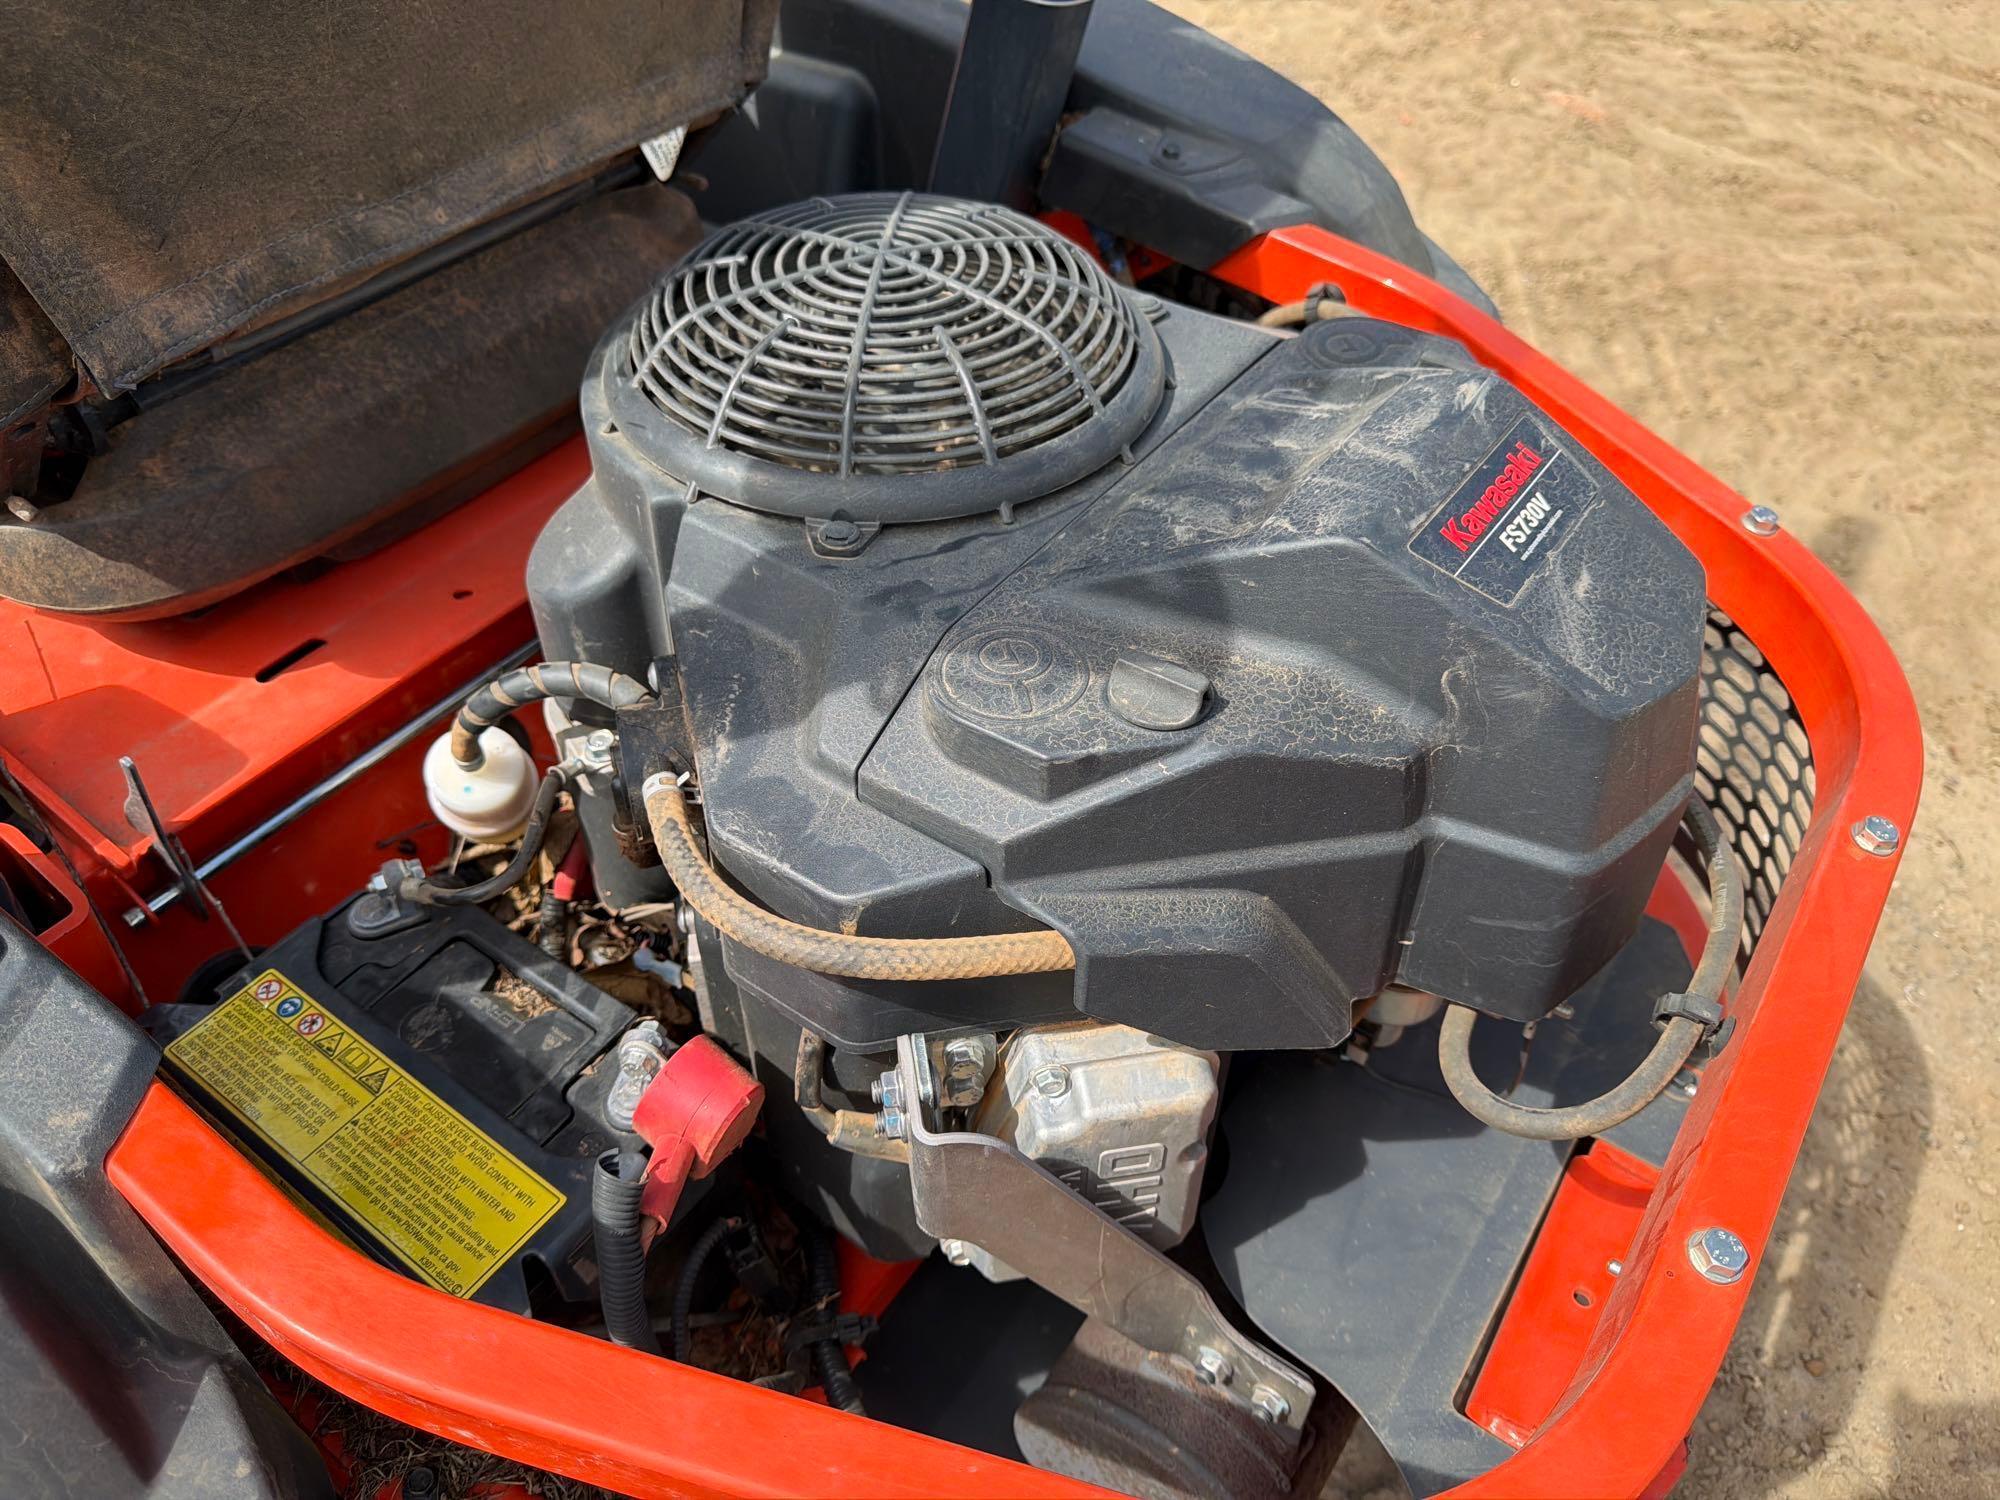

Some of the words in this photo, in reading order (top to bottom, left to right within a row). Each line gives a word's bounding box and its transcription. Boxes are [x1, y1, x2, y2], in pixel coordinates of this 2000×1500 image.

[1439, 441, 1543, 552] Kawasaki
[1499, 491, 1552, 553] FS730V
[173, 1043, 192, 1059] KEEP
[186, 1054, 203, 1068] OUT
[197, 1063, 211, 1075] OF
[204, 1070, 229, 1090] REACH
[223, 1085, 236, 1096] OF
[213, 1017, 240, 1038] ALWAYS
[234, 1034, 259, 1054] SHIELD
[253, 1050, 273, 1066] EYES
[267, 1062, 285, 1076] AND
[279, 1072, 299, 1087] FACE
[293, 1083, 315, 1101] FROM
[310, 1097, 340, 1122] BATTERY
[222, 1010, 250, 1032] BATTERY
[244, 1028, 258, 1039] TO
[238, 994, 264, 1015] DANGER
[263, 1014, 296, 1041] EXPLOSIVE
[292, 1037, 315, 1056] GASES
[264, 1029, 291, 1051] FLAMES
[286, 1047, 299, 1058] OR
[294, 1054, 322, 1076] SPARKS
[316, 1071, 341, 1092] COULD
[335, 1087, 360, 1107] CAUSE
[194, 1031, 219, 1051] ADJUST
[214, 1048, 234, 1064] POST
[229, 1061, 271, 1095] CONNECTIONS
[266, 1091, 297, 1117] WITHOUT
[291, 1113, 320, 1136] PROPER
[205, 1025, 217, 1035] DO
[212, 1031, 228, 1044] NOT
[223, 1040, 250, 1062] CHARGE
[244, 1058, 259, 1070] OR
[253, 1065, 270, 1079] USE
[264, 1075, 296, 1101] BOOSTER
[290, 1096, 317, 1119] CABLES
[312, 1114, 327, 1127] OR
[394, 1080, 422, 1102] POISON
[421, 1101, 450, 1124] CAUSES
[445, 1120, 474, 1143] SEVERE
[469, 1138, 496, 1161] BURNS
[362, 1111, 383, 1128] CALL
[377, 1124, 388, 1133] A
[383, 1128, 420, 1159] PHYSICIAN
[372, 1104, 384, 1115] IN
[379, 1111, 403, 1130] EVENT
[398, 1126, 412, 1137] OF
[408, 1133, 442, 1161] ACCIDENT
[436, 1157, 462, 1178] FLUSH
[457, 1173, 479, 1192] WITH
[474, 1187, 502, 1210] WATER
[497, 1205, 517, 1222] AND
[388, 1090, 423, 1118] CONTAINS
[418, 1113, 453, 1141] SULFURIC
[464, 1150, 489, 1170] AVOID
[484, 1166, 518, 1194] CONTACT
[513, 1189, 536, 1208] WITH
[396, 1110, 416, 1127] EYES
[411, 1122, 426, 1134] OR
[314, 1147, 330, 1160] For
[323, 1156, 343, 1172] more
[338, 1167, 375, 1199] information
[367, 1194, 382, 1207] go
[378, 1201, 390, 1211] to
[324, 1140, 339, 1153] and
[334, 1149, 353, 1164] birth
[347, 1160, 372, 1181] defects
[366, 1178, 377, 1187] or
[374, 1182, 395, 1200] other
[388, 1195, 429, 1230] reproductive
[332, 1133, 353, 1150] which
[348, 1145, 359, 1155] is
[354, 1150, 378, 1170] known
[373, 1166, 385, 1176] to
[379, 1171, 394, 1184] the
[388, 1178, 409, 1196] State
[403, 1191, 416, 1202] of
[410, 1196, 443, 1225] California
[437, 1219, 450, 1231] to
[444, 1226, 467, 1245] cause
[461, 1240, 487, 1262] cancer
[345, 1127, 363, 1142] This
[355, 1137, 383, 1160] product
[378, 1156, 393, 1168] can
[387, 1165, 412, 1186] expose
[407, 1181, 423, 1195] you
[419, 1189, 432, 1200] to
[426, 1194, 461, 1223] chemicals
[453, 1218, 487, 1247] including
[356, 1121, 395, 1154] CALIFORNIA
[390, 1150, 436, 1188] PROPOSITION
[431, 1183, 445, 1195] 65
[440, 1191, 478, 1221] WARNING:
